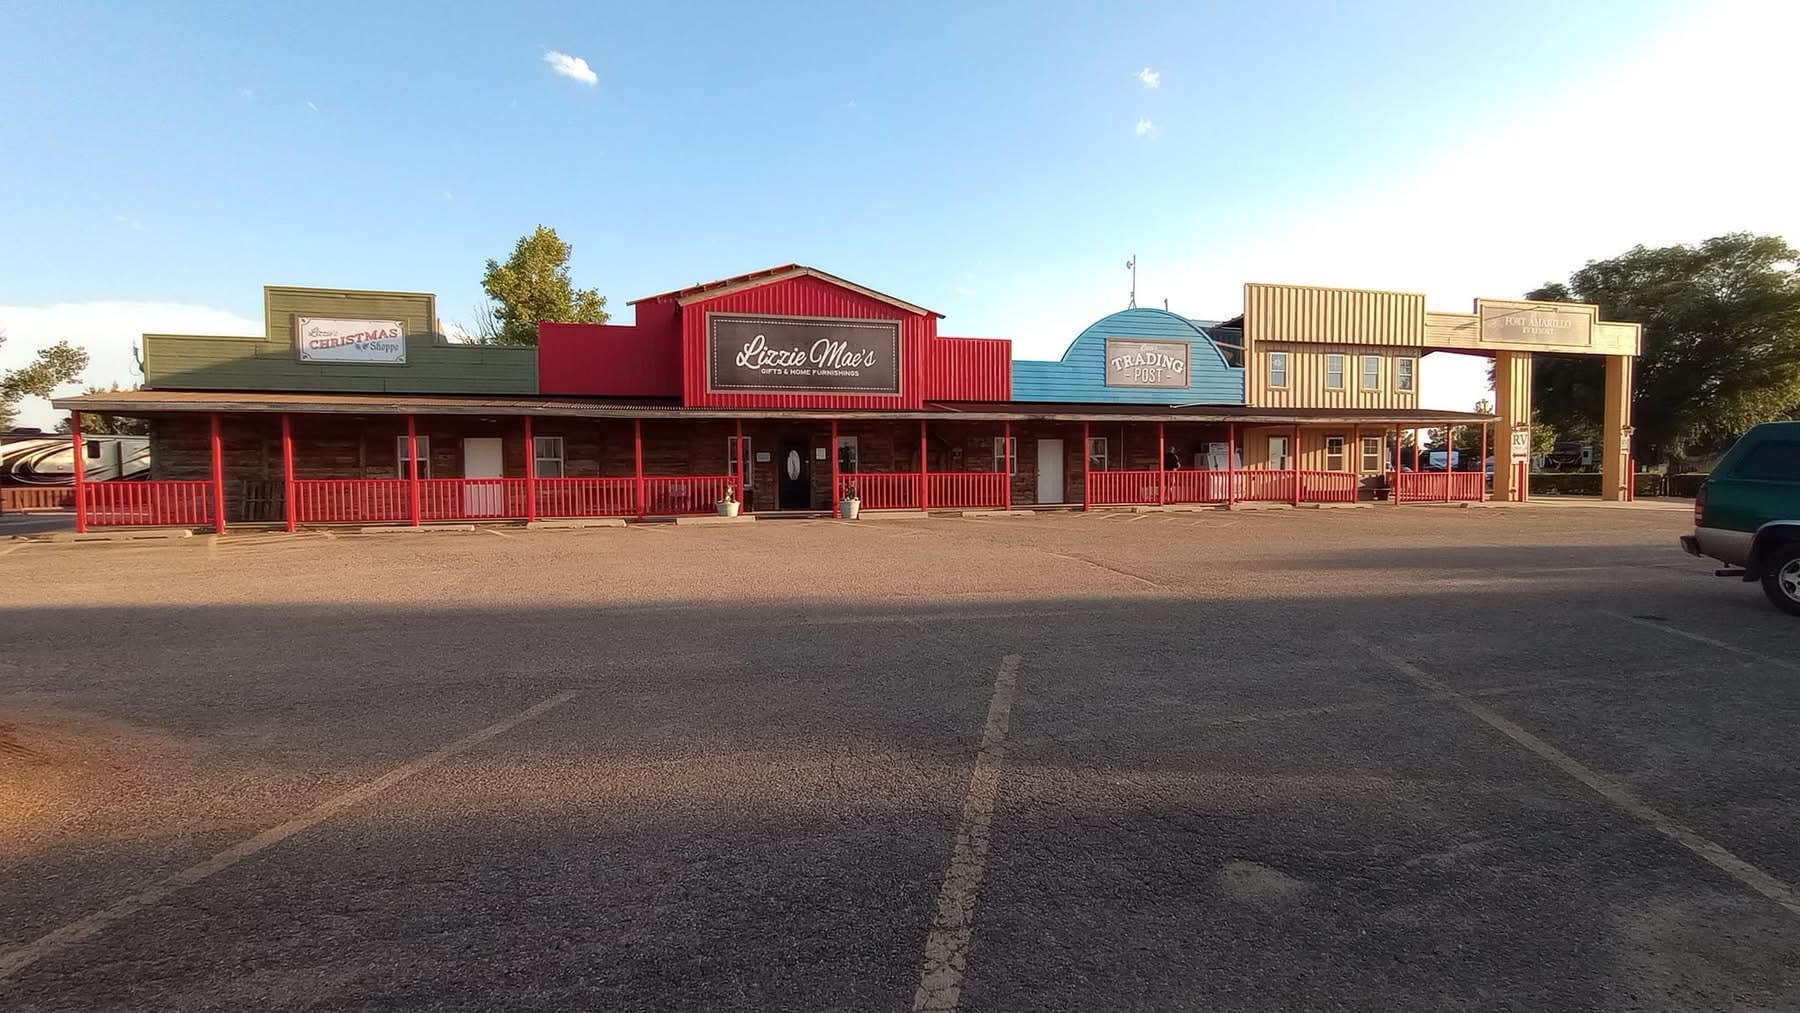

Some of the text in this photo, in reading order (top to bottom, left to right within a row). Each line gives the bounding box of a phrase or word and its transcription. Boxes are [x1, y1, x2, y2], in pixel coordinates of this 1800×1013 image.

[1527, 318, 1572, 329] AMARILLO
[309, 328, 398, 350] CHRISTMAS
[370, 341, 399, 353] Shoppe
[735, 334, 876, 370] Lizzie Mae's
[1111, 352, 1184, 373] TRADING
[812, 369, 860, 377] FURNISHINGS
[1134, 367, 1162, 384] POST
[1512, 434, 1528, 446] RV
